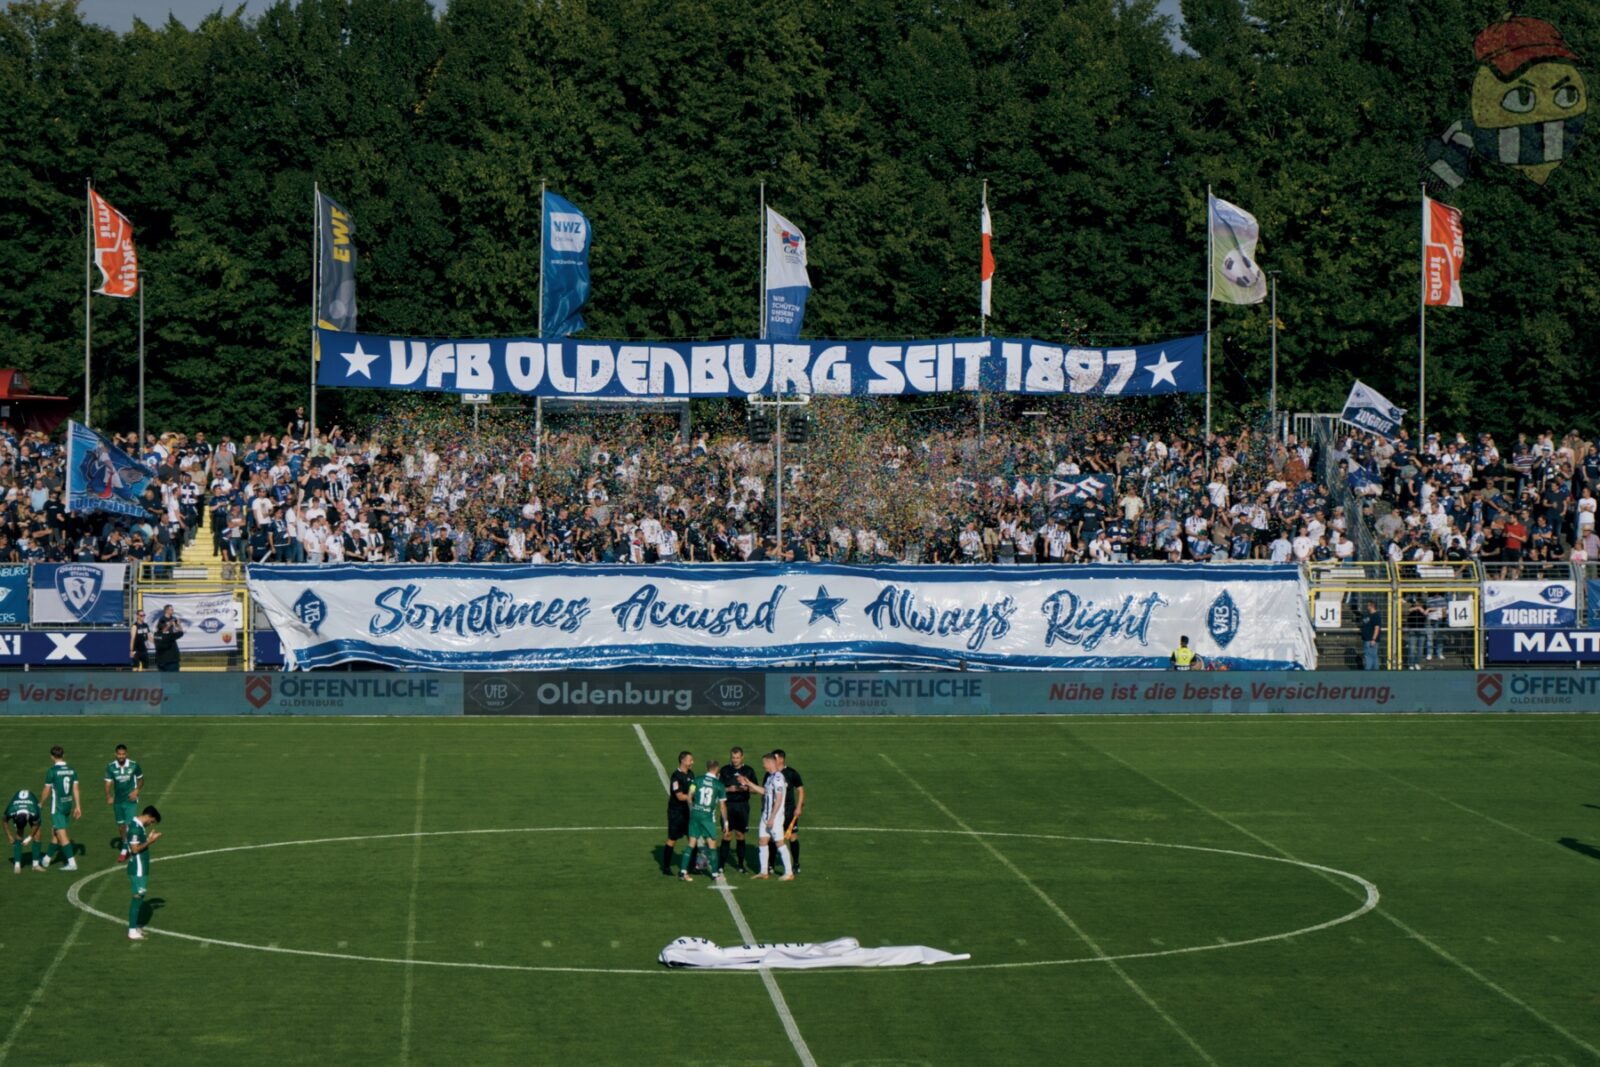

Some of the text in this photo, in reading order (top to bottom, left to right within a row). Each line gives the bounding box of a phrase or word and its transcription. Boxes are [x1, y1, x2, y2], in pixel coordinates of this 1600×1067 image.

[331, 206, 351, 262] EWE
[553, 220, 582, 234] NWZ
[1431, 257, 1446, 301] irma
[504, 342, 851, 395] OLDENBURG
[867, 340, 991, 393] SEIT
[1002, 342, 1136, 396] 1897
[369, 583, 1168, 652] Sometimes Accused Always Right
[1320, 608, 1335, 620] J1
[1501, 608, 1558, 625] ZUGRIFF
[1513, 632, 1600, 652] MATT
[19, 683, 168, 706] Versicherung.
[280, 675, 439, 698] ÖFFENTLICHE
[483, 684, 508, 699] VfB
[719, 684, 744, 699] VfB
[824, 676, 982, 698] ÖFFENTLICHE
[1050, 682, 1396, 705] Nähe ist die beste Versicherung.
[1510, 674, 1600, 695] ÖFFENT
[280, 699, 344, 707] OLDENBURG
[537, 681, 692, 711] Oldenburg
[824, 699, 888, 708] OLDENBURG
[1510, 696, 1572, 705] OLDENBURG
[63, 776, 71, 795] 6
[698, 786, 713, 806] 13
